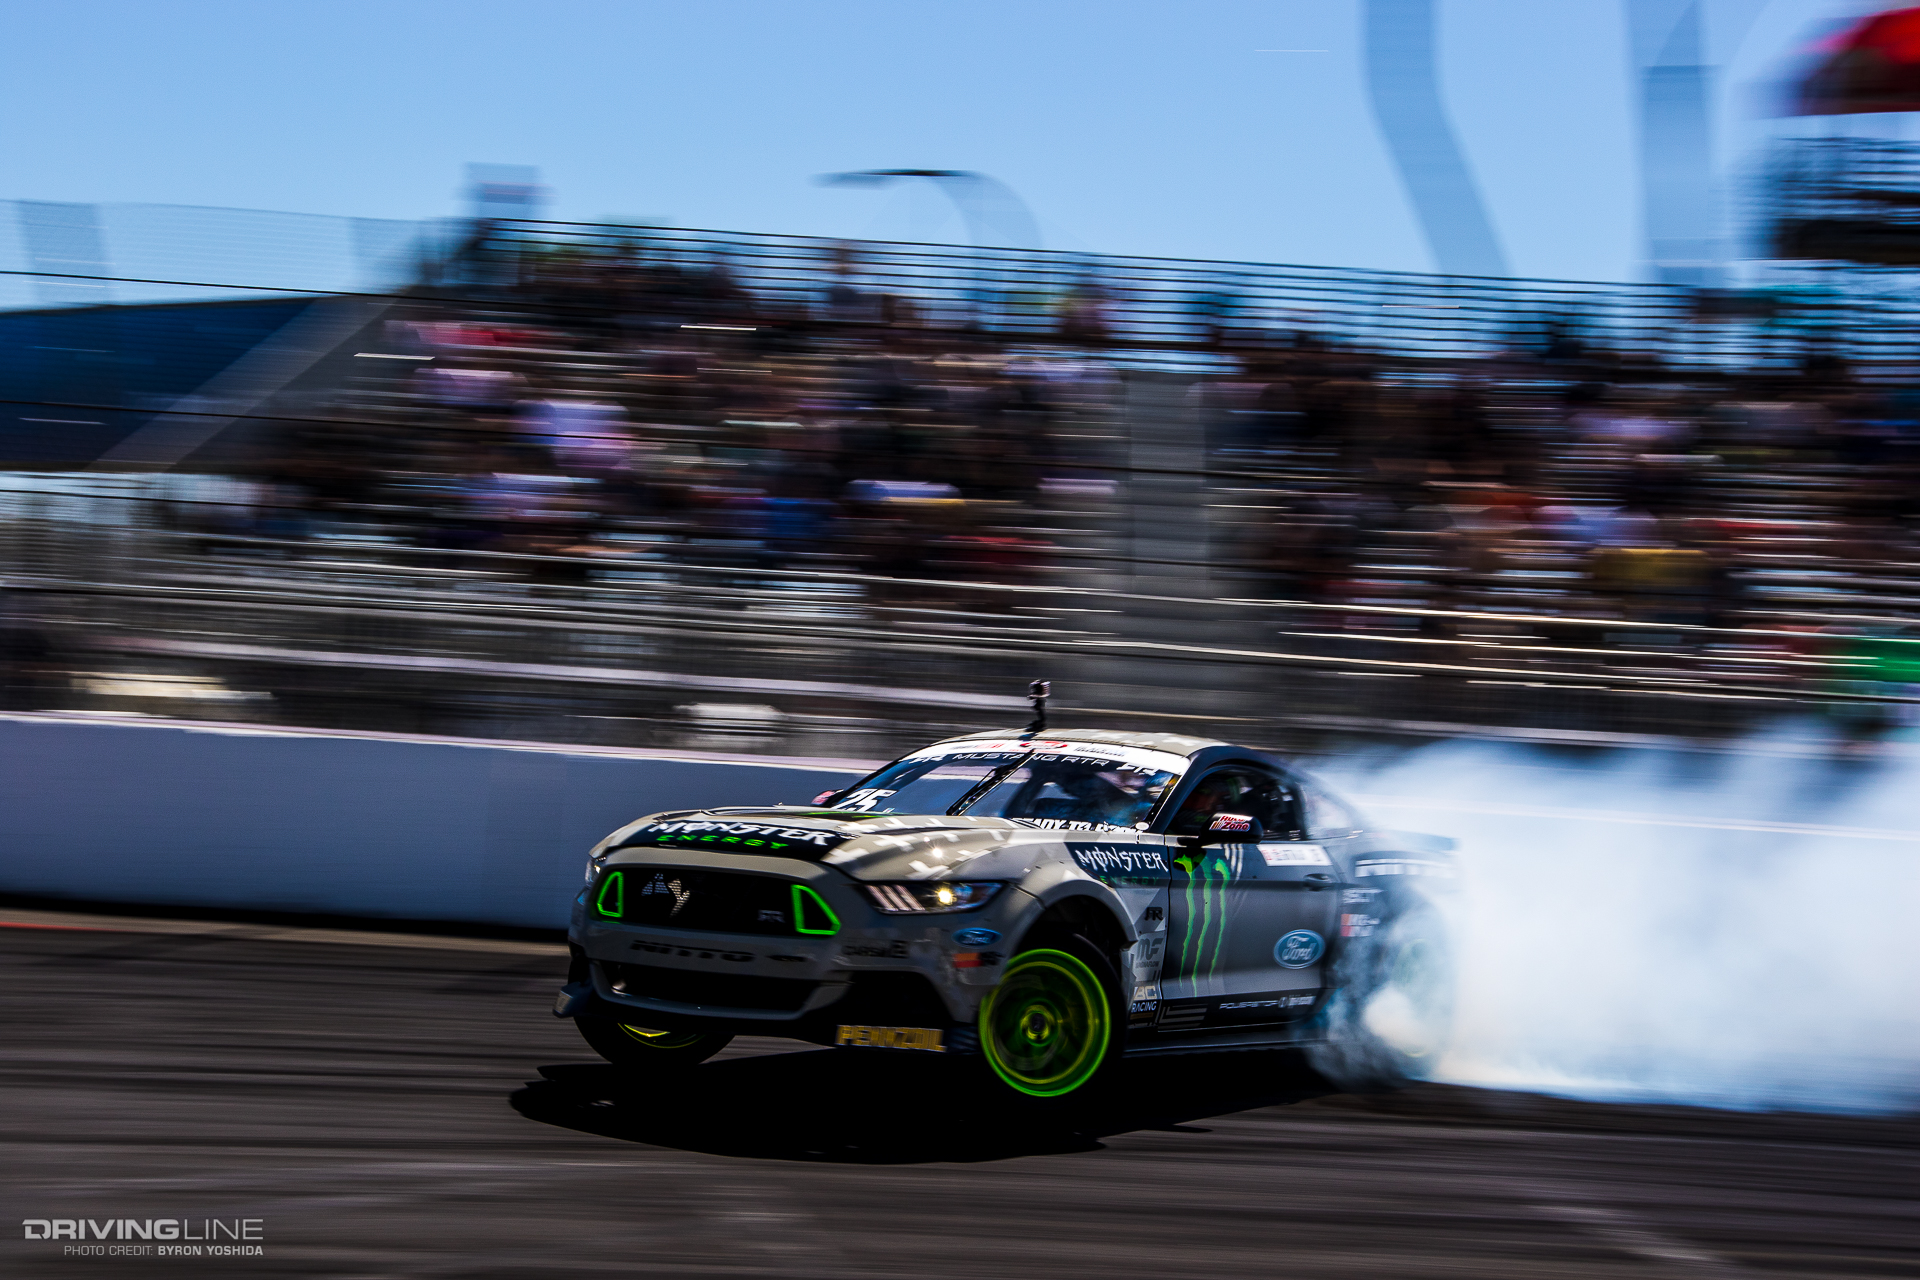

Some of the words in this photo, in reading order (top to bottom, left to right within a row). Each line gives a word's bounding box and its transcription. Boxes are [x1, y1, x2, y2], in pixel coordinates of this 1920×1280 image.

[952, 752, 1058, 763] MUSTANG
[1060, 756, 1111, 767] RTR
[831, 788, 899, 812] 25
[647, 821, 836, 847] MONSTER
[1221, 821, 1250, 830] Zone
[656, 834, 789, 850] ENERGY
[1075, 846, 1169, 873] MONSTER
[1100, 875, 1160, 886] ENERGY
[629, 939, 757, 963] NITTO
[1281, 935, 1318, 962] Ford
[1131, 1001, 1158, 1013] RACING
